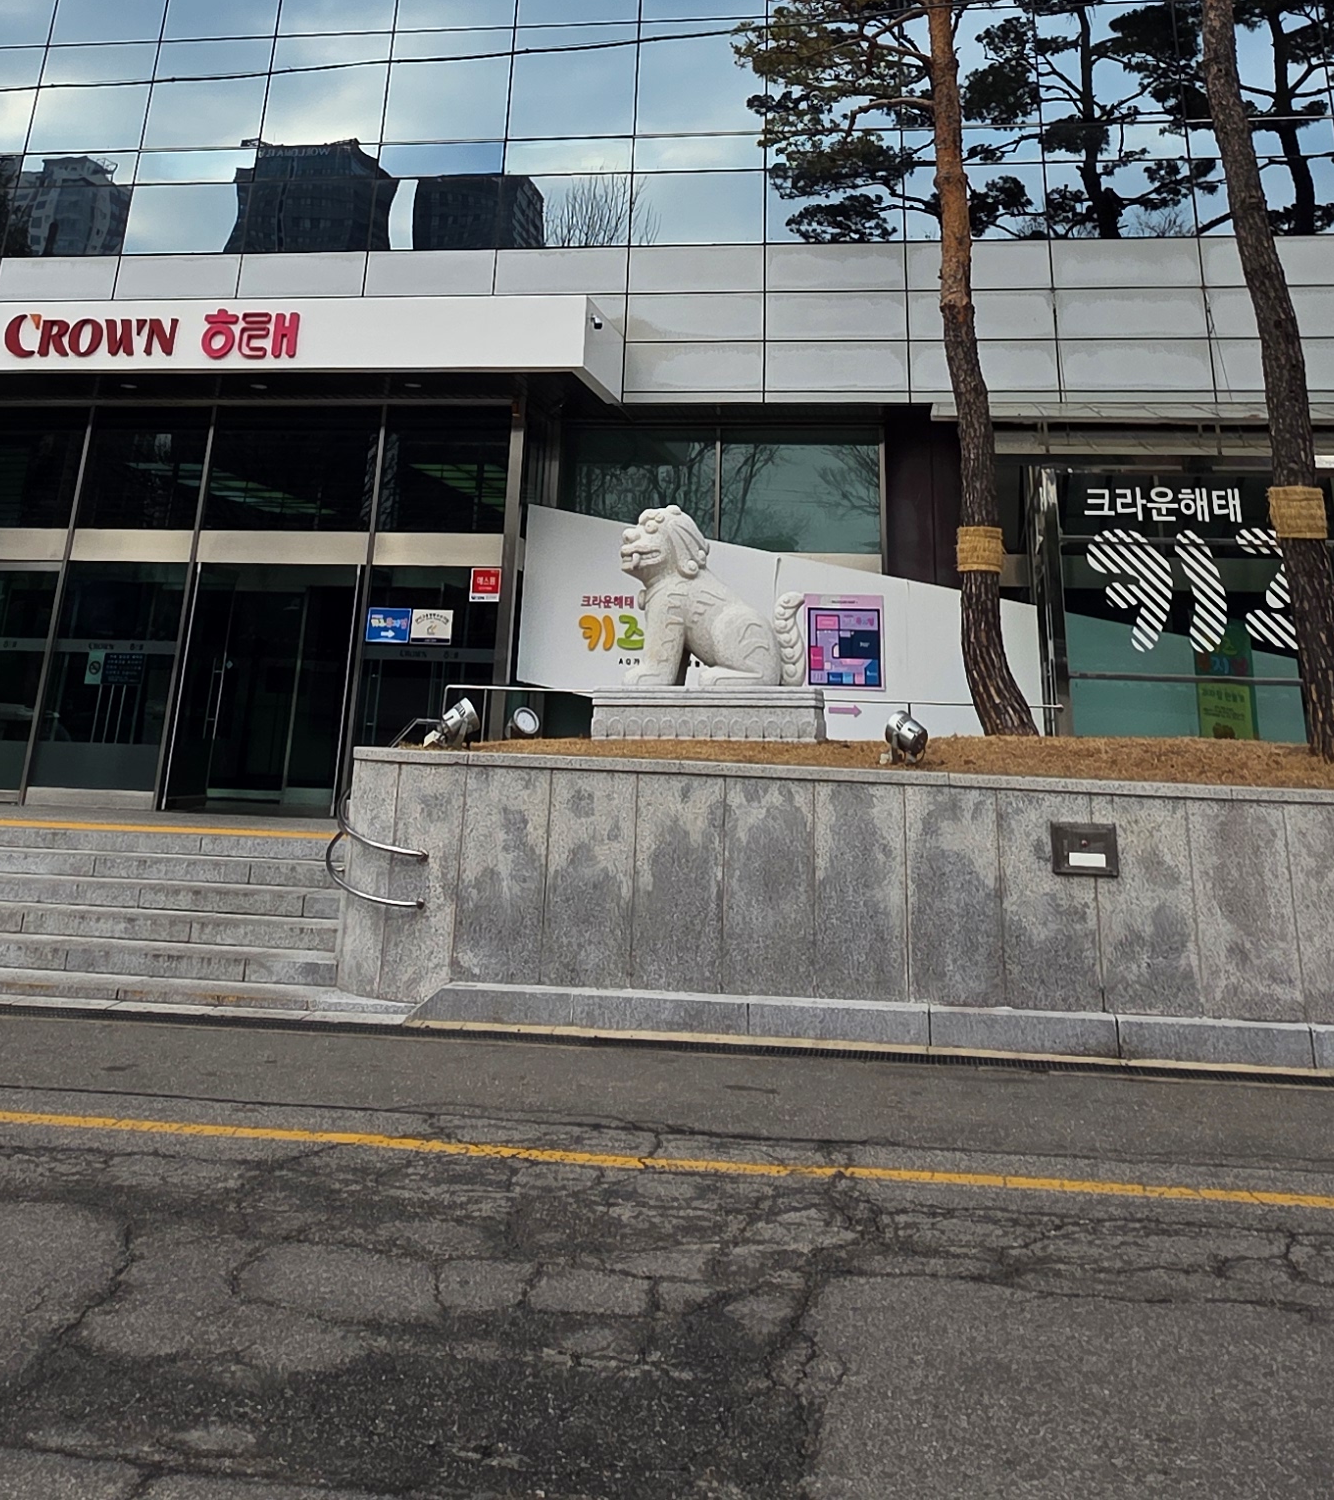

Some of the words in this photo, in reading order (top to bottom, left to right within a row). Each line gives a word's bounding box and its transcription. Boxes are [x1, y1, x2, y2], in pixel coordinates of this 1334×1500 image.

[3, 313, 180, 359] CROWN
[1083, 486, 1244, 524] 크라운해태
[580, 595, 635, 609] 크라운해태
